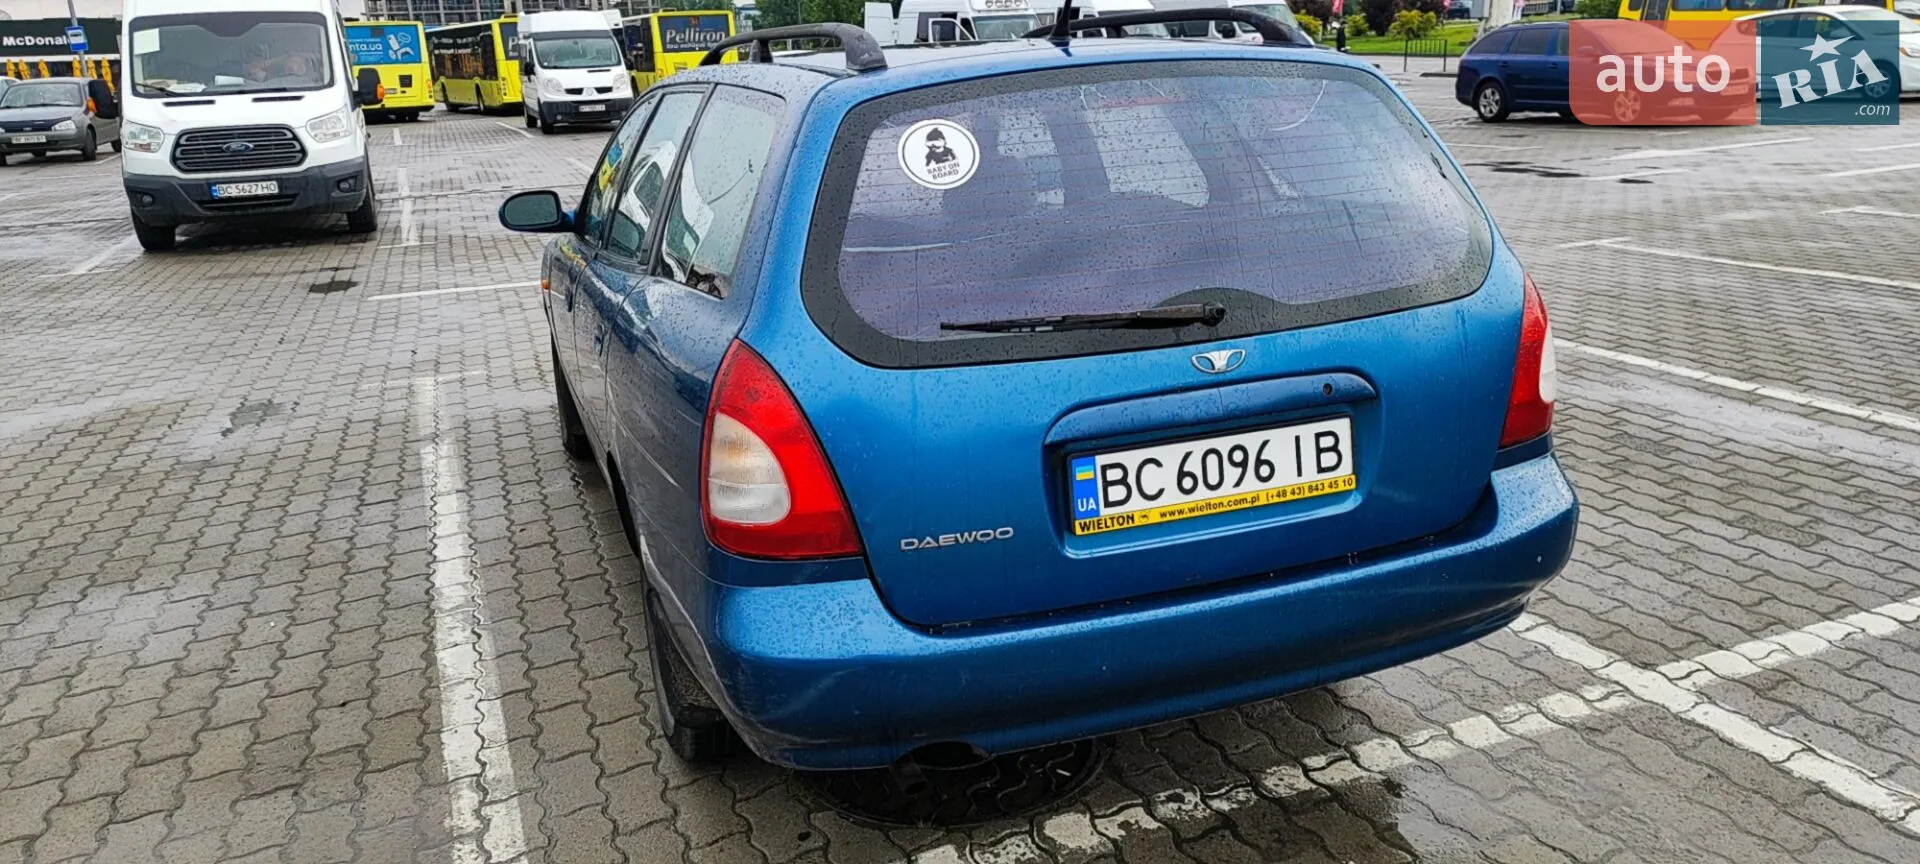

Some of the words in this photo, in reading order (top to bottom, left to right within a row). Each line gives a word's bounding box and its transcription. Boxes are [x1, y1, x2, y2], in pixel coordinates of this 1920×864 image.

[2, 35, 71, 46] McDonal
[666, 27, 726, 43] Pelliron
[927, 164, 948, 175] BABY
[947, 161, 960, 170] ON
[932, 168, 959, 180] BOARD
[234, 183, 260, 194] 5627
[1100, 457, 1165, 509] BC
[1176, 439, 1276, 495] 6096
[1077, 496, 1097, 512] UA
[1078, 513, 1135, 533] WIELTON
[1159, 493, 1260, 518] www.wielton.com.pl
[1265, 488, 1288, 503] (+48
[1289, 485, 1306, 497] 43)
[1307, 482, 1326, 494] 843
[1327, 479, 1340, 490] 45
[1342, 477, 1354, 488] 10
[900, 526, 1014, 551] DAEWOO
